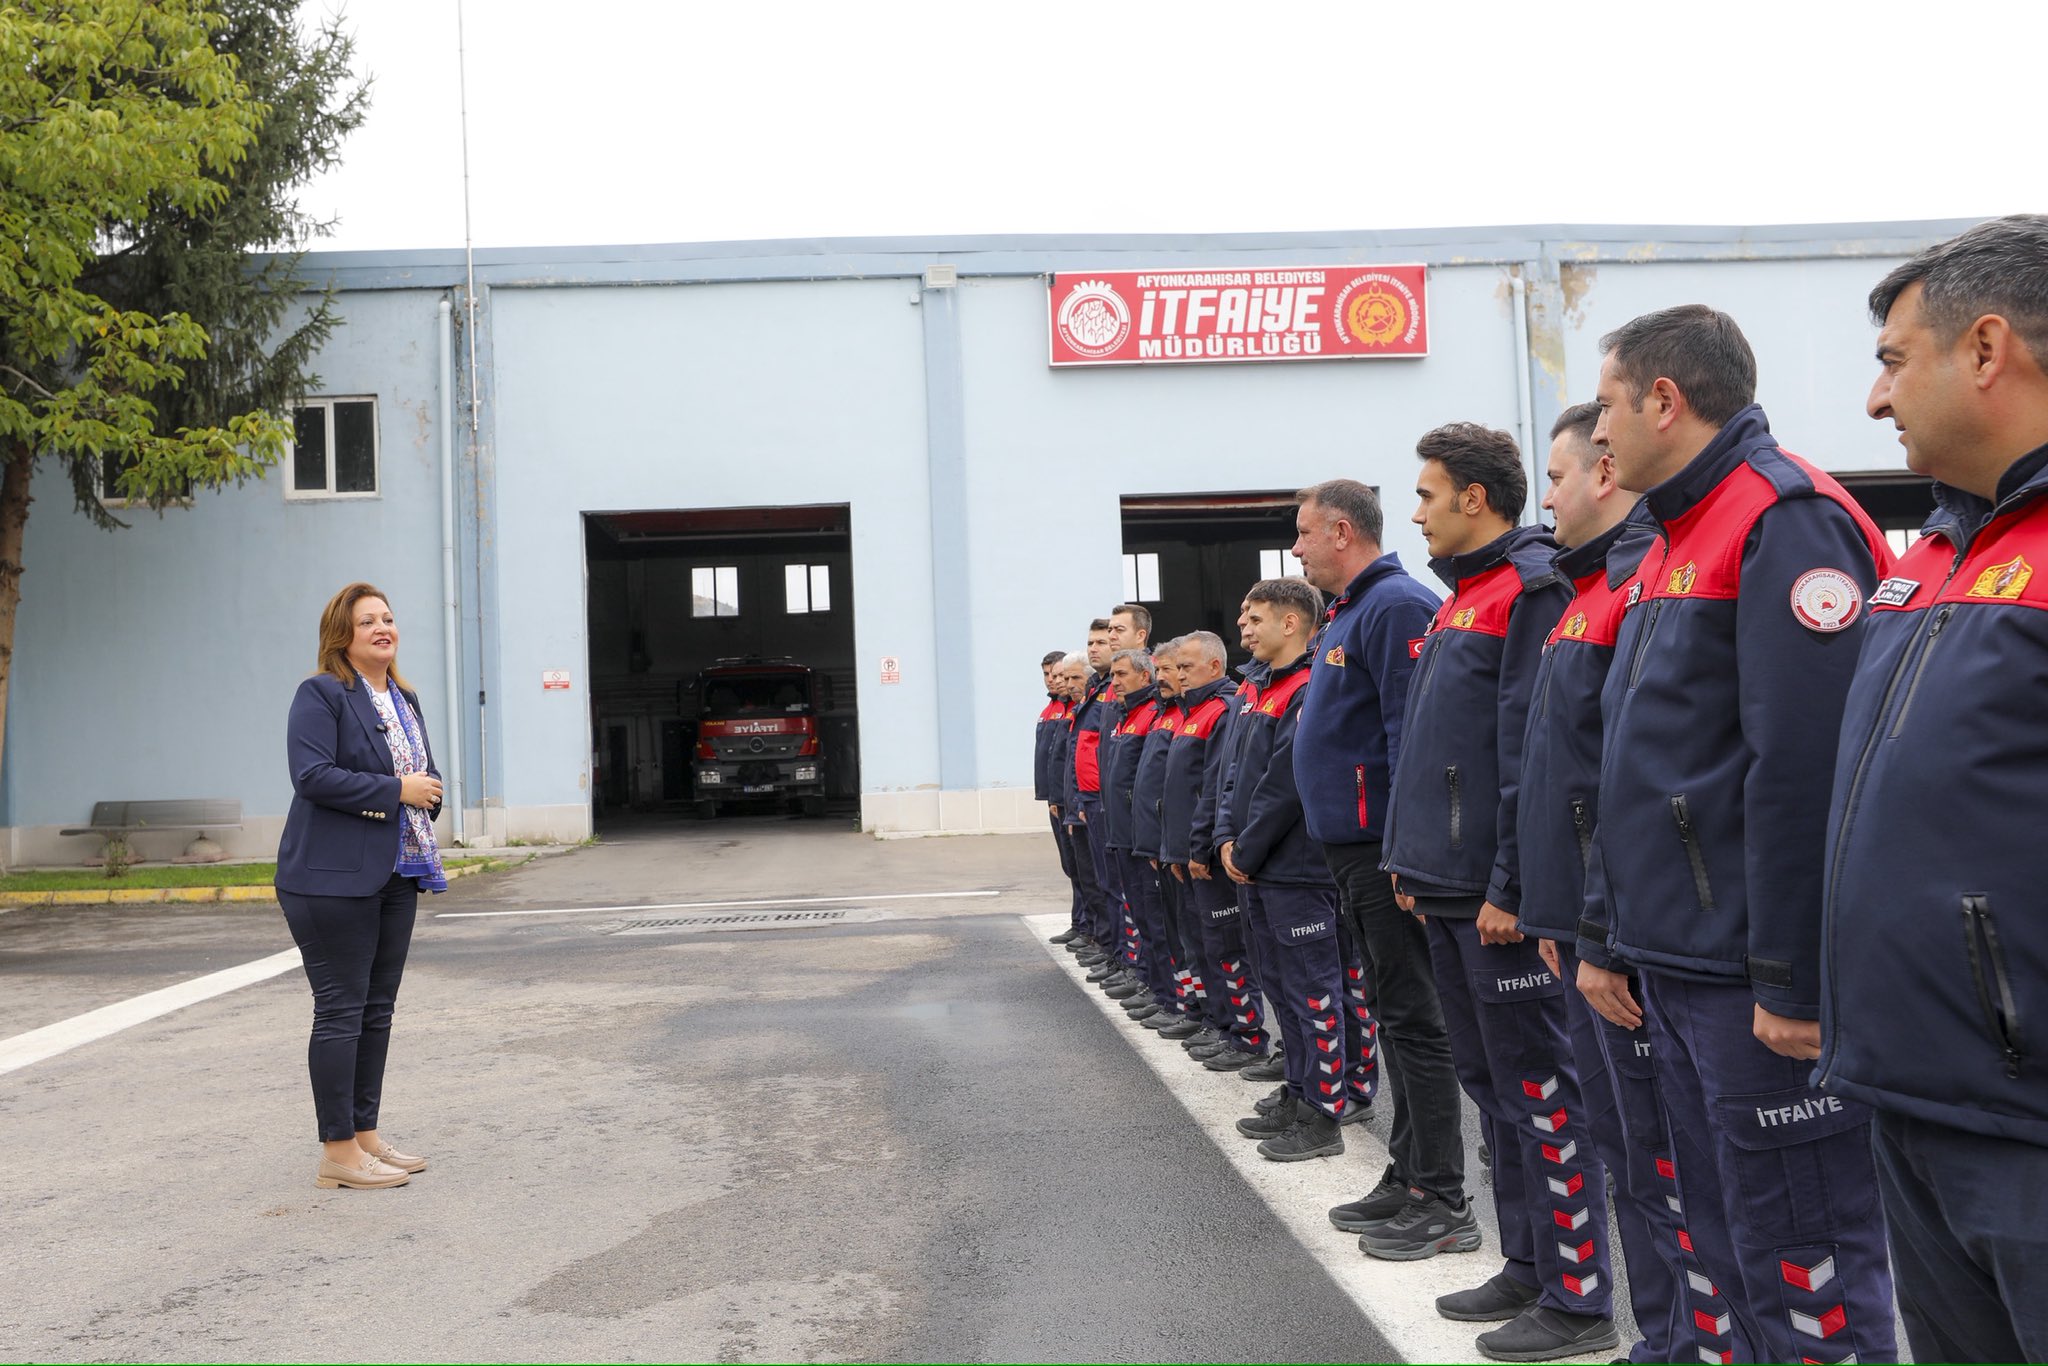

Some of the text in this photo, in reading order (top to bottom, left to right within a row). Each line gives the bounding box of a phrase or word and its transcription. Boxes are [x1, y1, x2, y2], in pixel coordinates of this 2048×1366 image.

[1137, 271, 1326, 288] AFYONKARAHİSAR BELEDİYESİ
[1139, 287, 1325, 336] İTFAİYE
[1139, 332, 1322, 358] MÜDÜRLÜĞÜ
[1211, 905, 1240, 919] İTFAİYE
[1291, 922, 1326, 938] İTFAİYE
[1496, 972, 1552, 992] İTFAİYE
[1756, 1096, 1844, 1128] İTFAİYE
